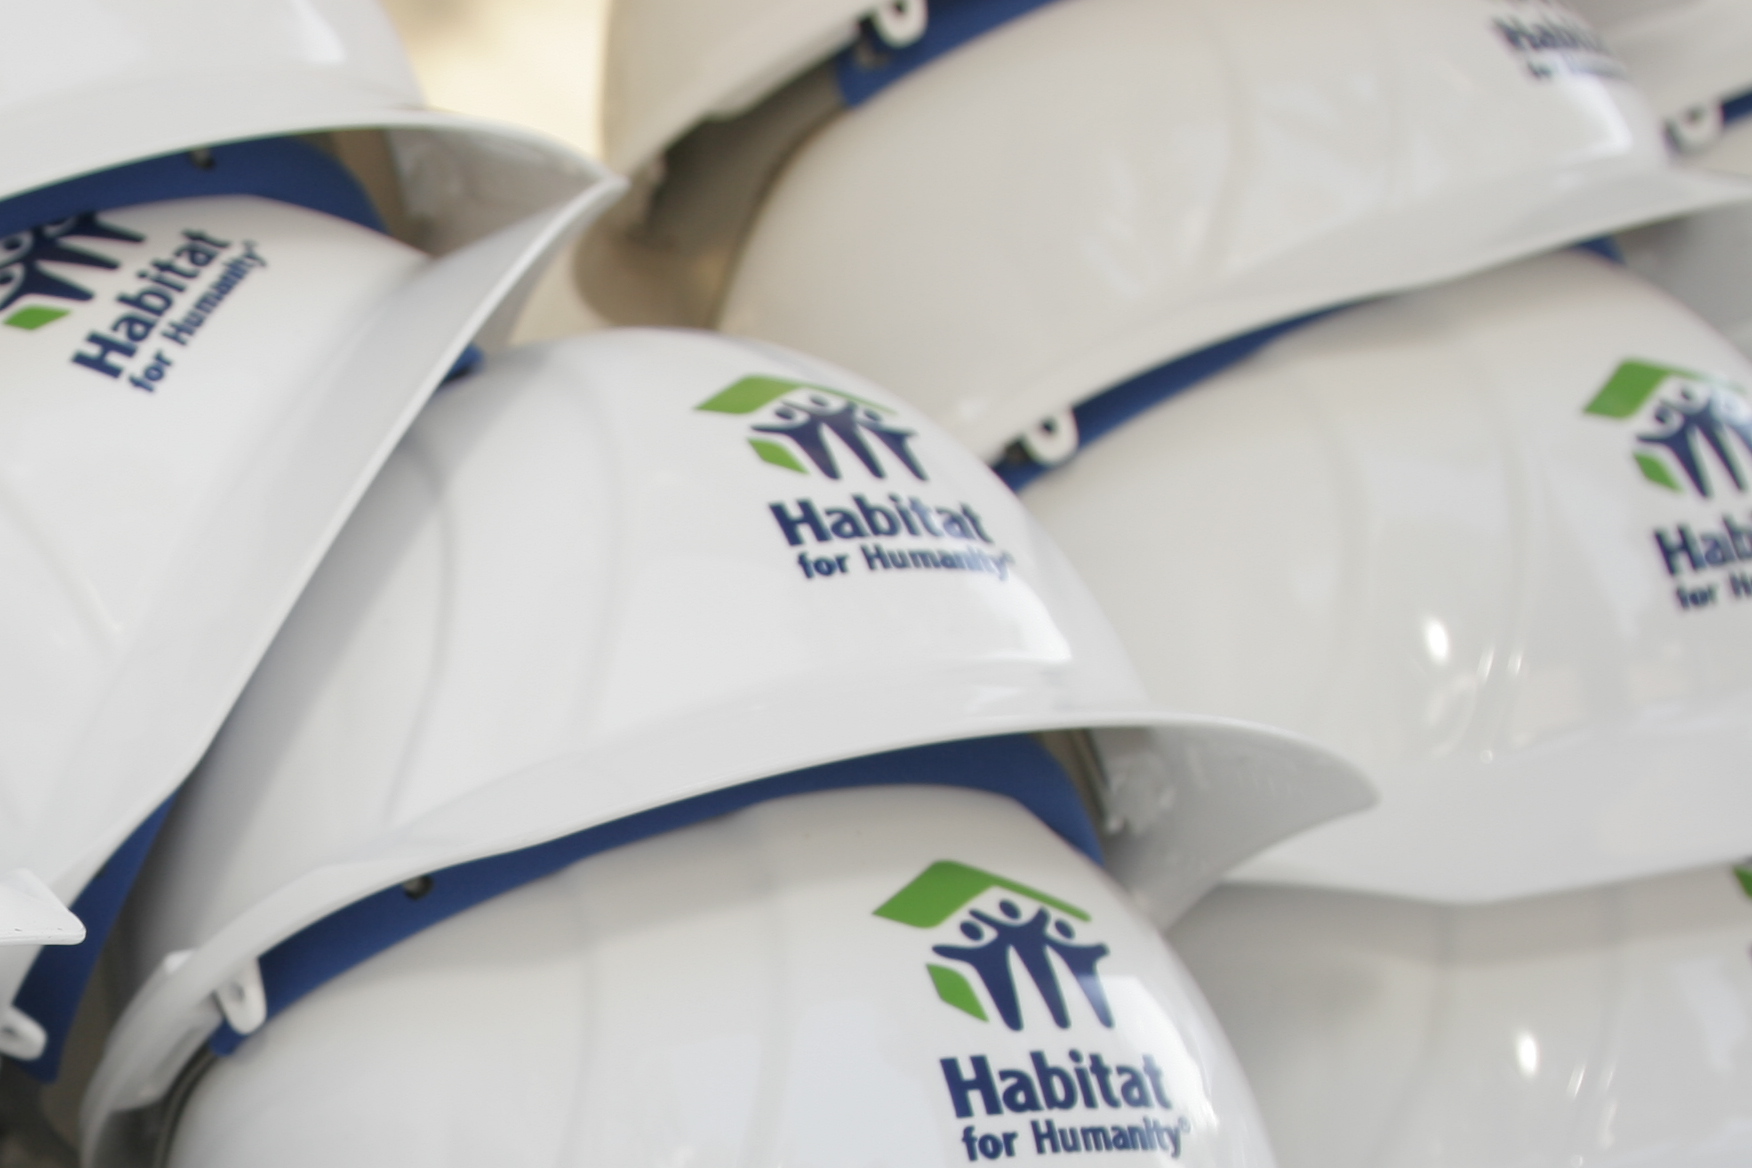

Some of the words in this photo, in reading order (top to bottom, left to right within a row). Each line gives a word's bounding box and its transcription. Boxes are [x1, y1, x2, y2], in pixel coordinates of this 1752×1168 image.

[70, 229, 231, 380] Habitat
[128, 349, 174, 394] for
[768, 493, 995, 546] Habitat
[797, 549, 851, 579] for
[939, 1049, 1173, 1119] Habitat
[961, 1125, 1019, 1162] for
